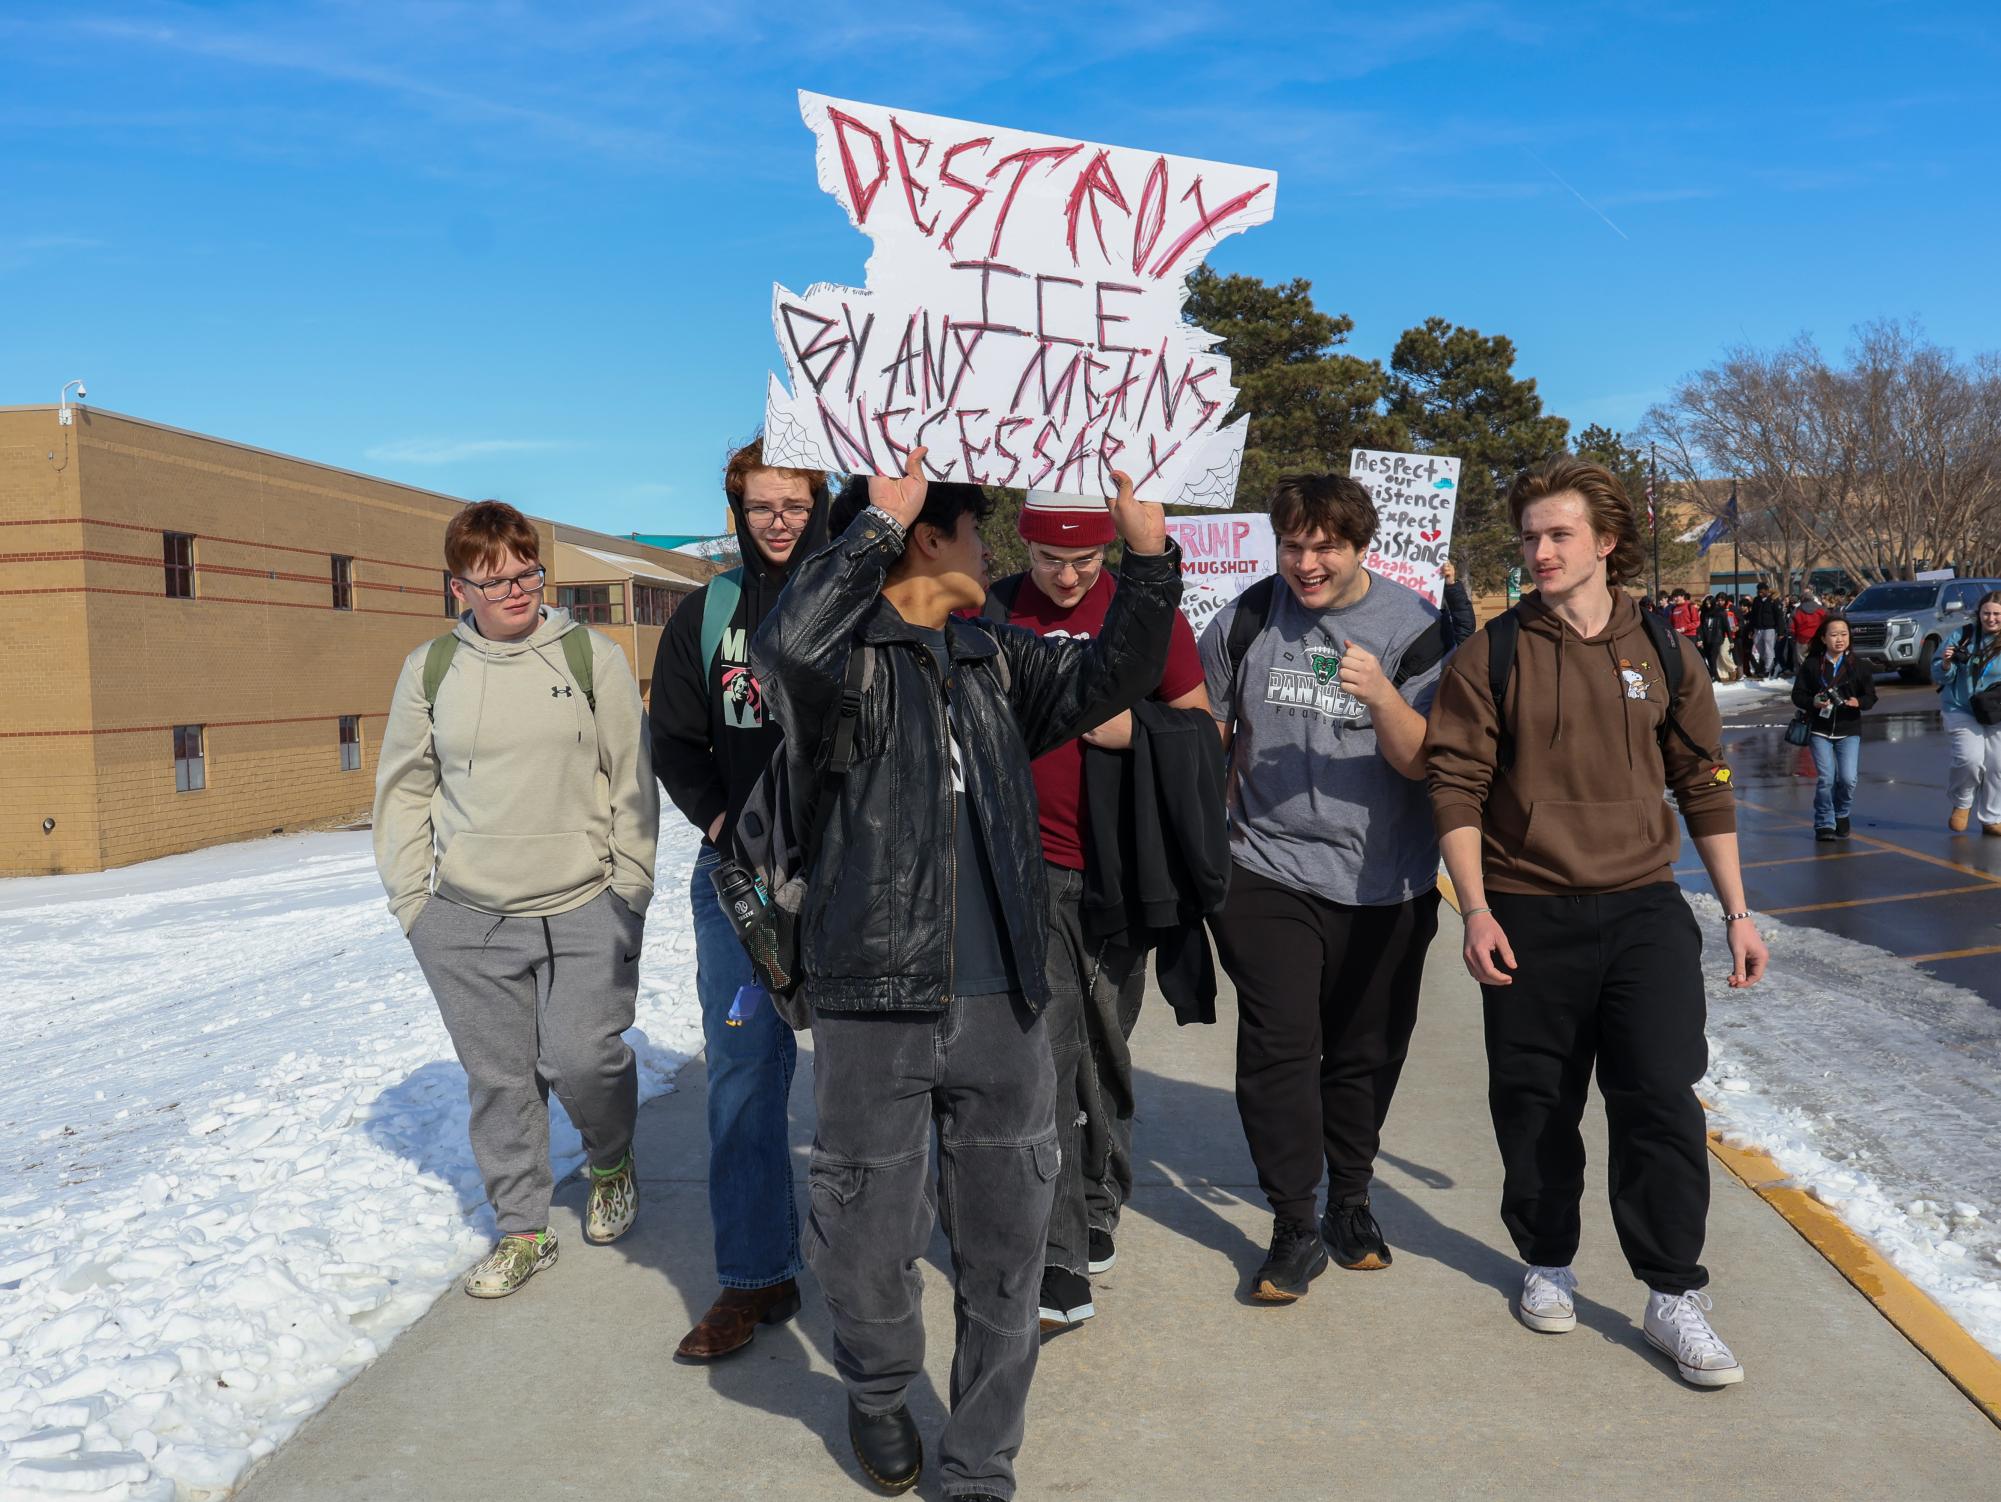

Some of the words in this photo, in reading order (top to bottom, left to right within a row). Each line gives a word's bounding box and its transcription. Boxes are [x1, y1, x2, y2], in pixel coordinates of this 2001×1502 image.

[827, 105, 1270, 280] DESTROY
[950, 257, 1153, 356] ICE
[779, 302, 875, 402] BY
[881, 306, 984, 414] ANY
[1009, 336, 1221, 440] MEANS
[815, 391, 1182, 502] NECESSARY
[1385, 474, 1416, 488] our
[1179, 560, 1258, 575] MUGSHOT
